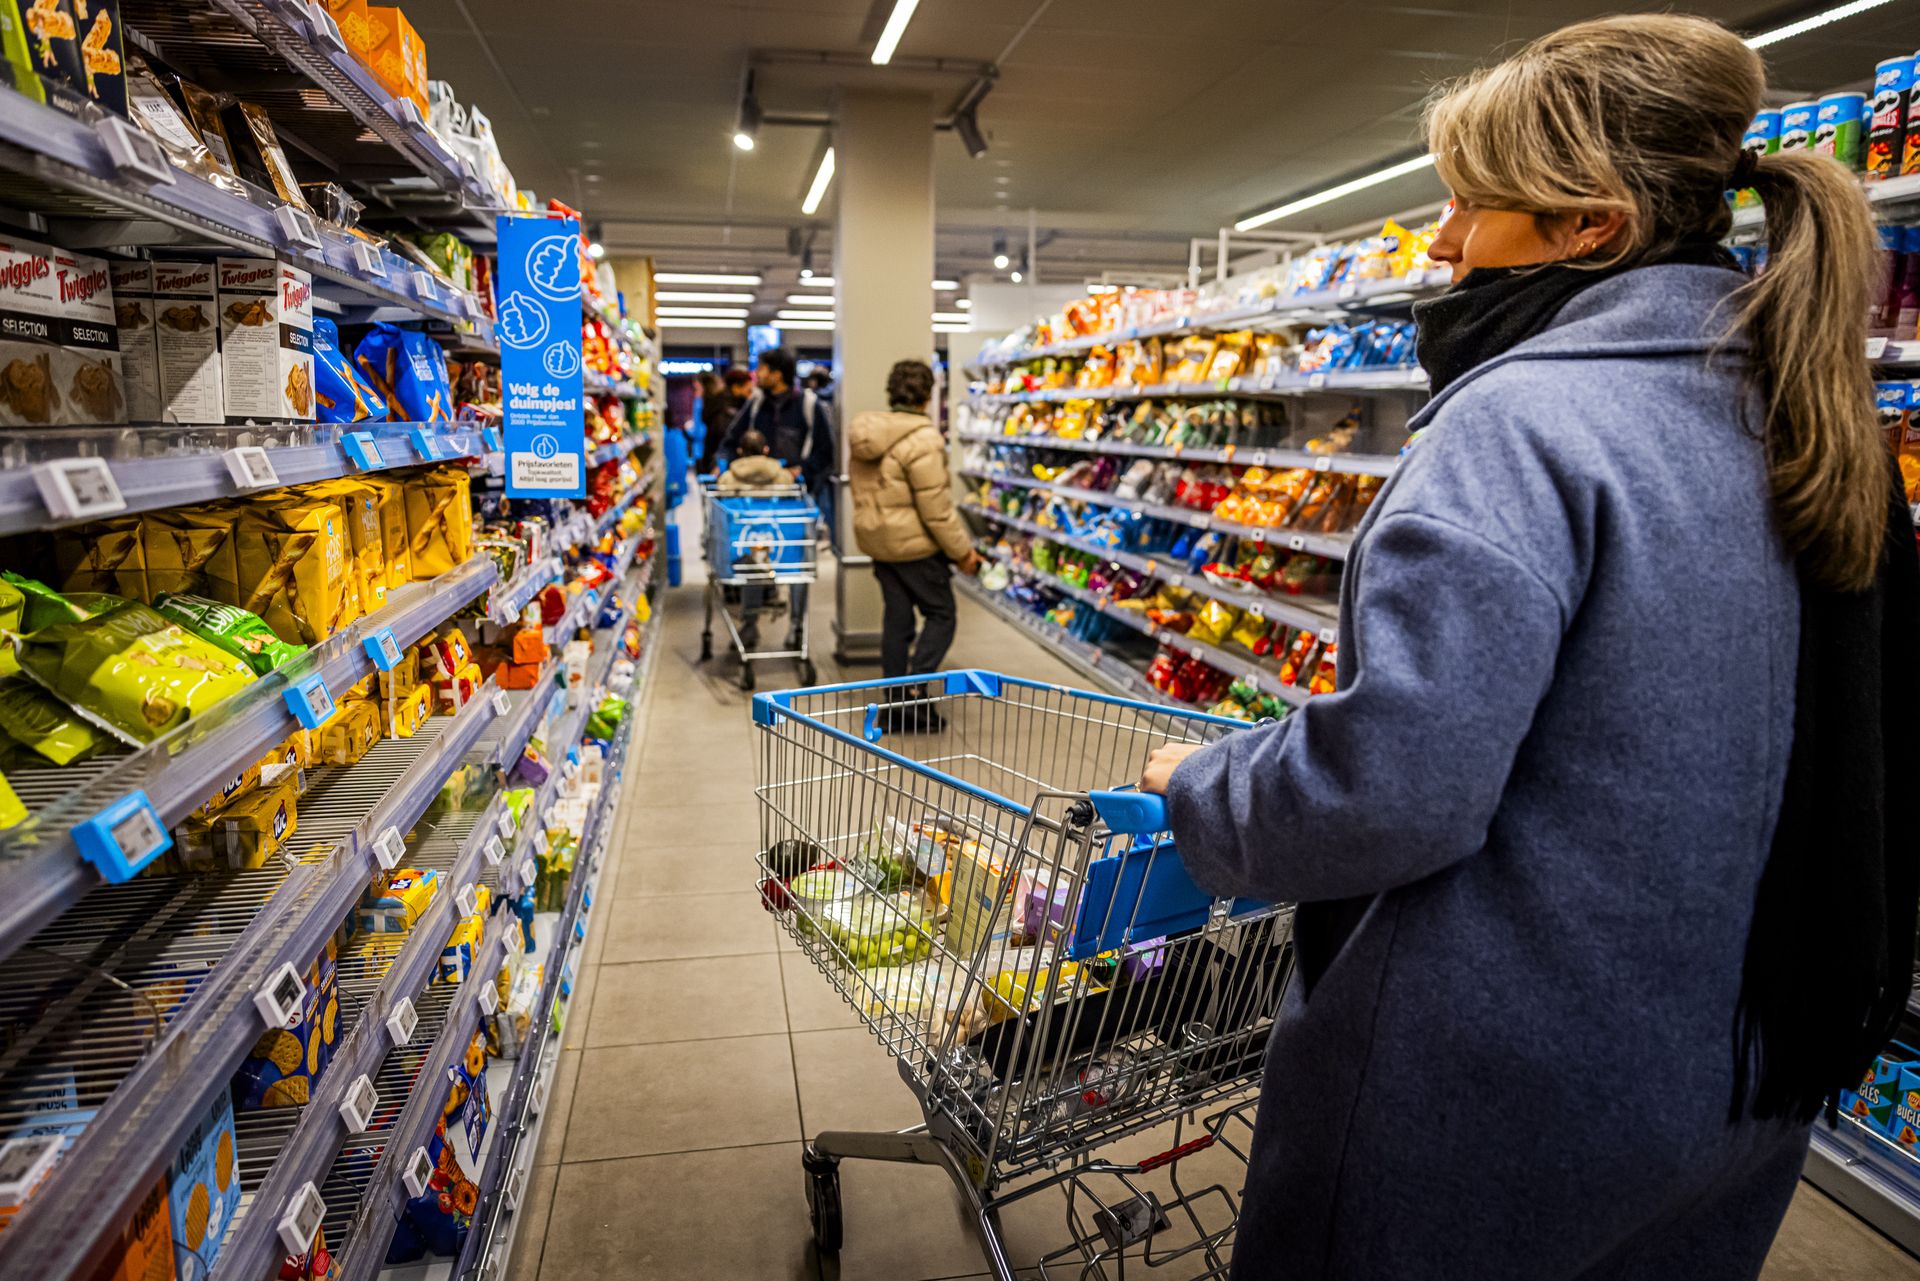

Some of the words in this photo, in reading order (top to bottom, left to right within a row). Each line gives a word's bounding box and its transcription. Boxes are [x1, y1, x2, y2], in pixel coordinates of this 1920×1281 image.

[0, 254, 49, 290] wiggles
[155, 272, 210, 292] Twiggles
[221, 268, 275, 287] Twiggles
[56, 268, 108, 304] Twiggles
[283, 281, 311, 312] Twiggles
[2, 318, 48, 337] SELECTION
[72, 326, 109, 344] SELECTION
[289, 331, 310, 348] SELECTION
[508, 382, 540, 399] Volg
[542, 383, 560, 397] de
[509, 396, 576, 412] duimpjes!
[273, 812, 287, 838] TUC
[1858, 1082, 1880, 1105] GLES
[1896, 1103, 1920, 1128] BUGLE
